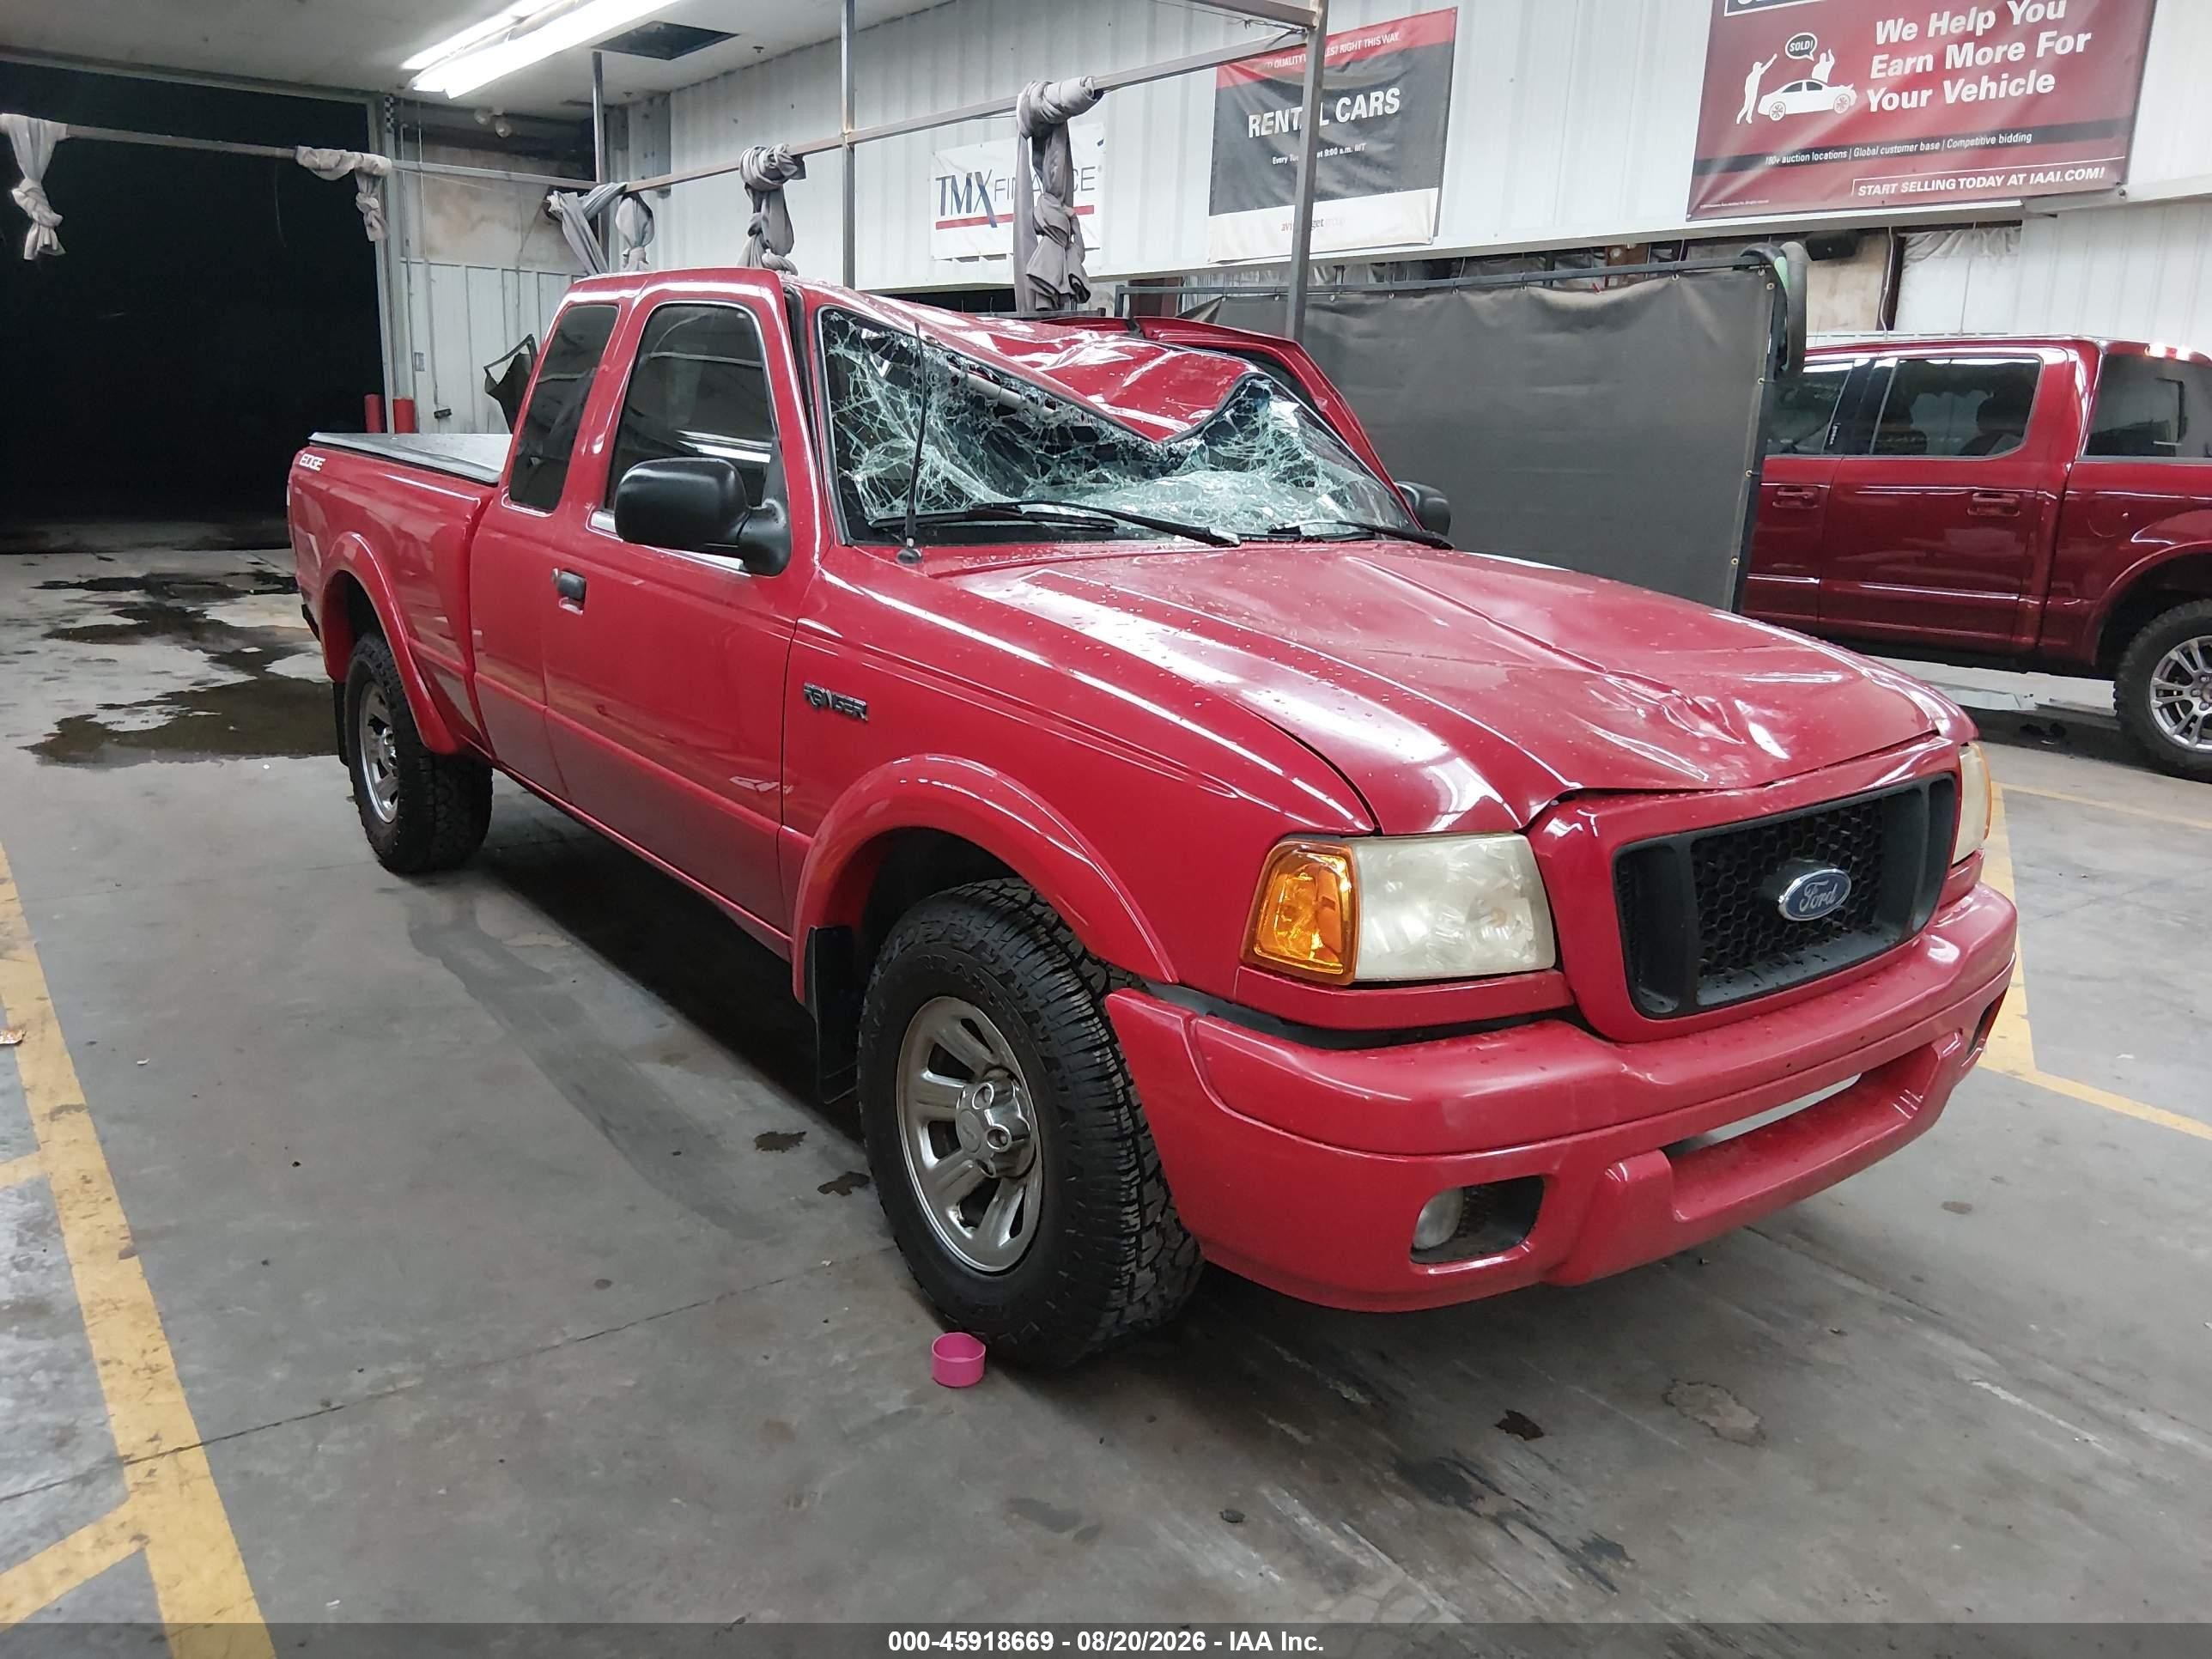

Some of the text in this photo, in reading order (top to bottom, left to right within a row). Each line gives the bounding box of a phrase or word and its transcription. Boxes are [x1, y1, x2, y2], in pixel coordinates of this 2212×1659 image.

[1876, 0, 2067, 45] We Help You
[1339, 40, 1363, 54] RIGHT
[1364, 35, 1382, 49] THIS
[1382, 32, 1401, 45] WAY
[1790, 40, 1814, 52] SOLD!
[1870, 31, 2092, 79] Earn More For
[1273, 54, 1303, 69] QUALITY
[1867, 69, 2056, 112] Your Vehicle
[1248, 88, 1401, 138] RENTL CARS
[1782, 154, 1810, 164] auction
[1812, 149, 1847, 161] locations
[1854, 145, 1879, 158] Global
[1880, 143, 1918, 155] customer
[1919, 141, 1941, 152] base
[1947, 135, 1996, 149] Competitive
[1998, 131, 2033, 144] bidding
[935, 169, 998, 228] TMX
[1857, 167, 2106, 197] START SELLING TODAY AT IAAI.COM!
[299, 453, 326, 471] EDGE
[1799, 879, 1838, 913] Ford
